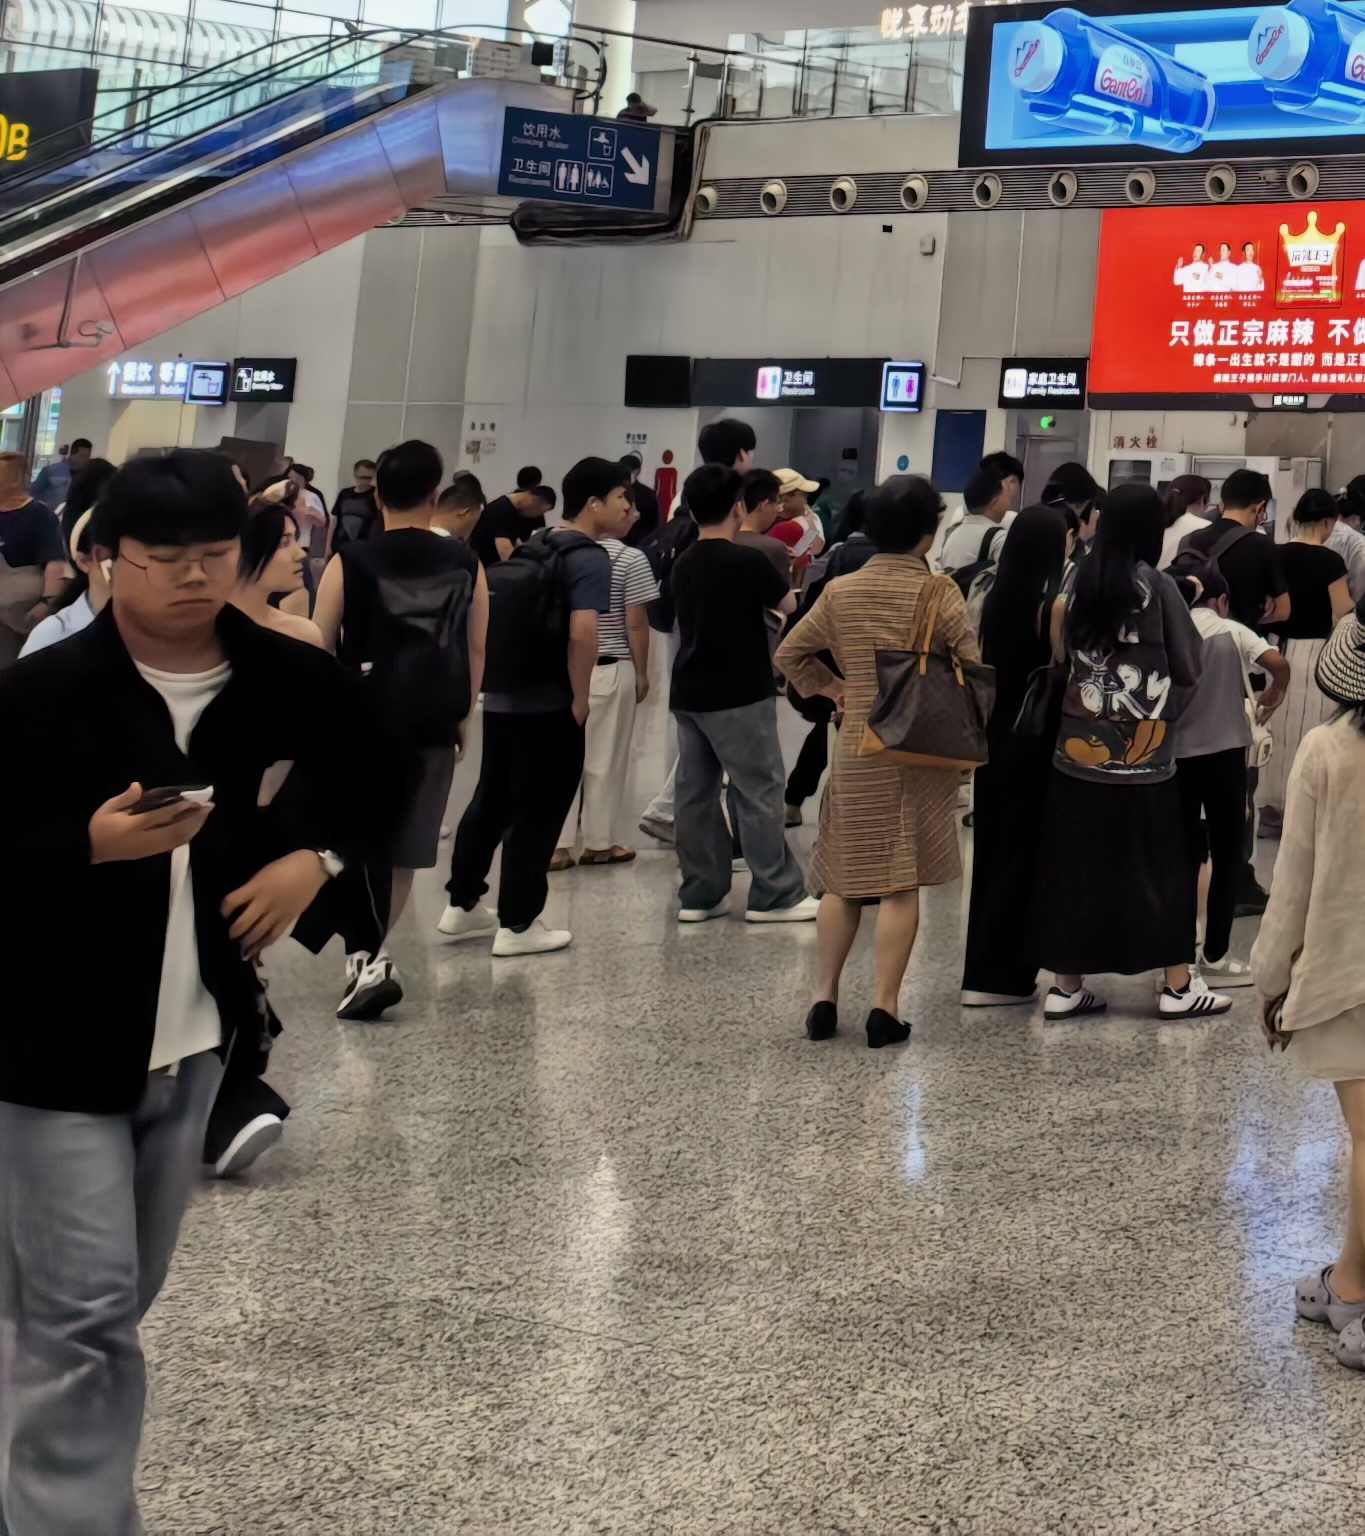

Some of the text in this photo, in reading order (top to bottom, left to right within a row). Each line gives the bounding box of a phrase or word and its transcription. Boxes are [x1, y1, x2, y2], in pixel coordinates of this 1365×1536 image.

[522, 122, 561, 140] 饮用水
[512, 158, 551, 176] 卫生间
[1168, 317, 1315, 347] 只做正宗麻辣
[782, 371, 814, 386] 卫生间
[1027, 372, 1078, 387] 家庭卫生间
[1113, 435, 1158, 449] 消火栓
